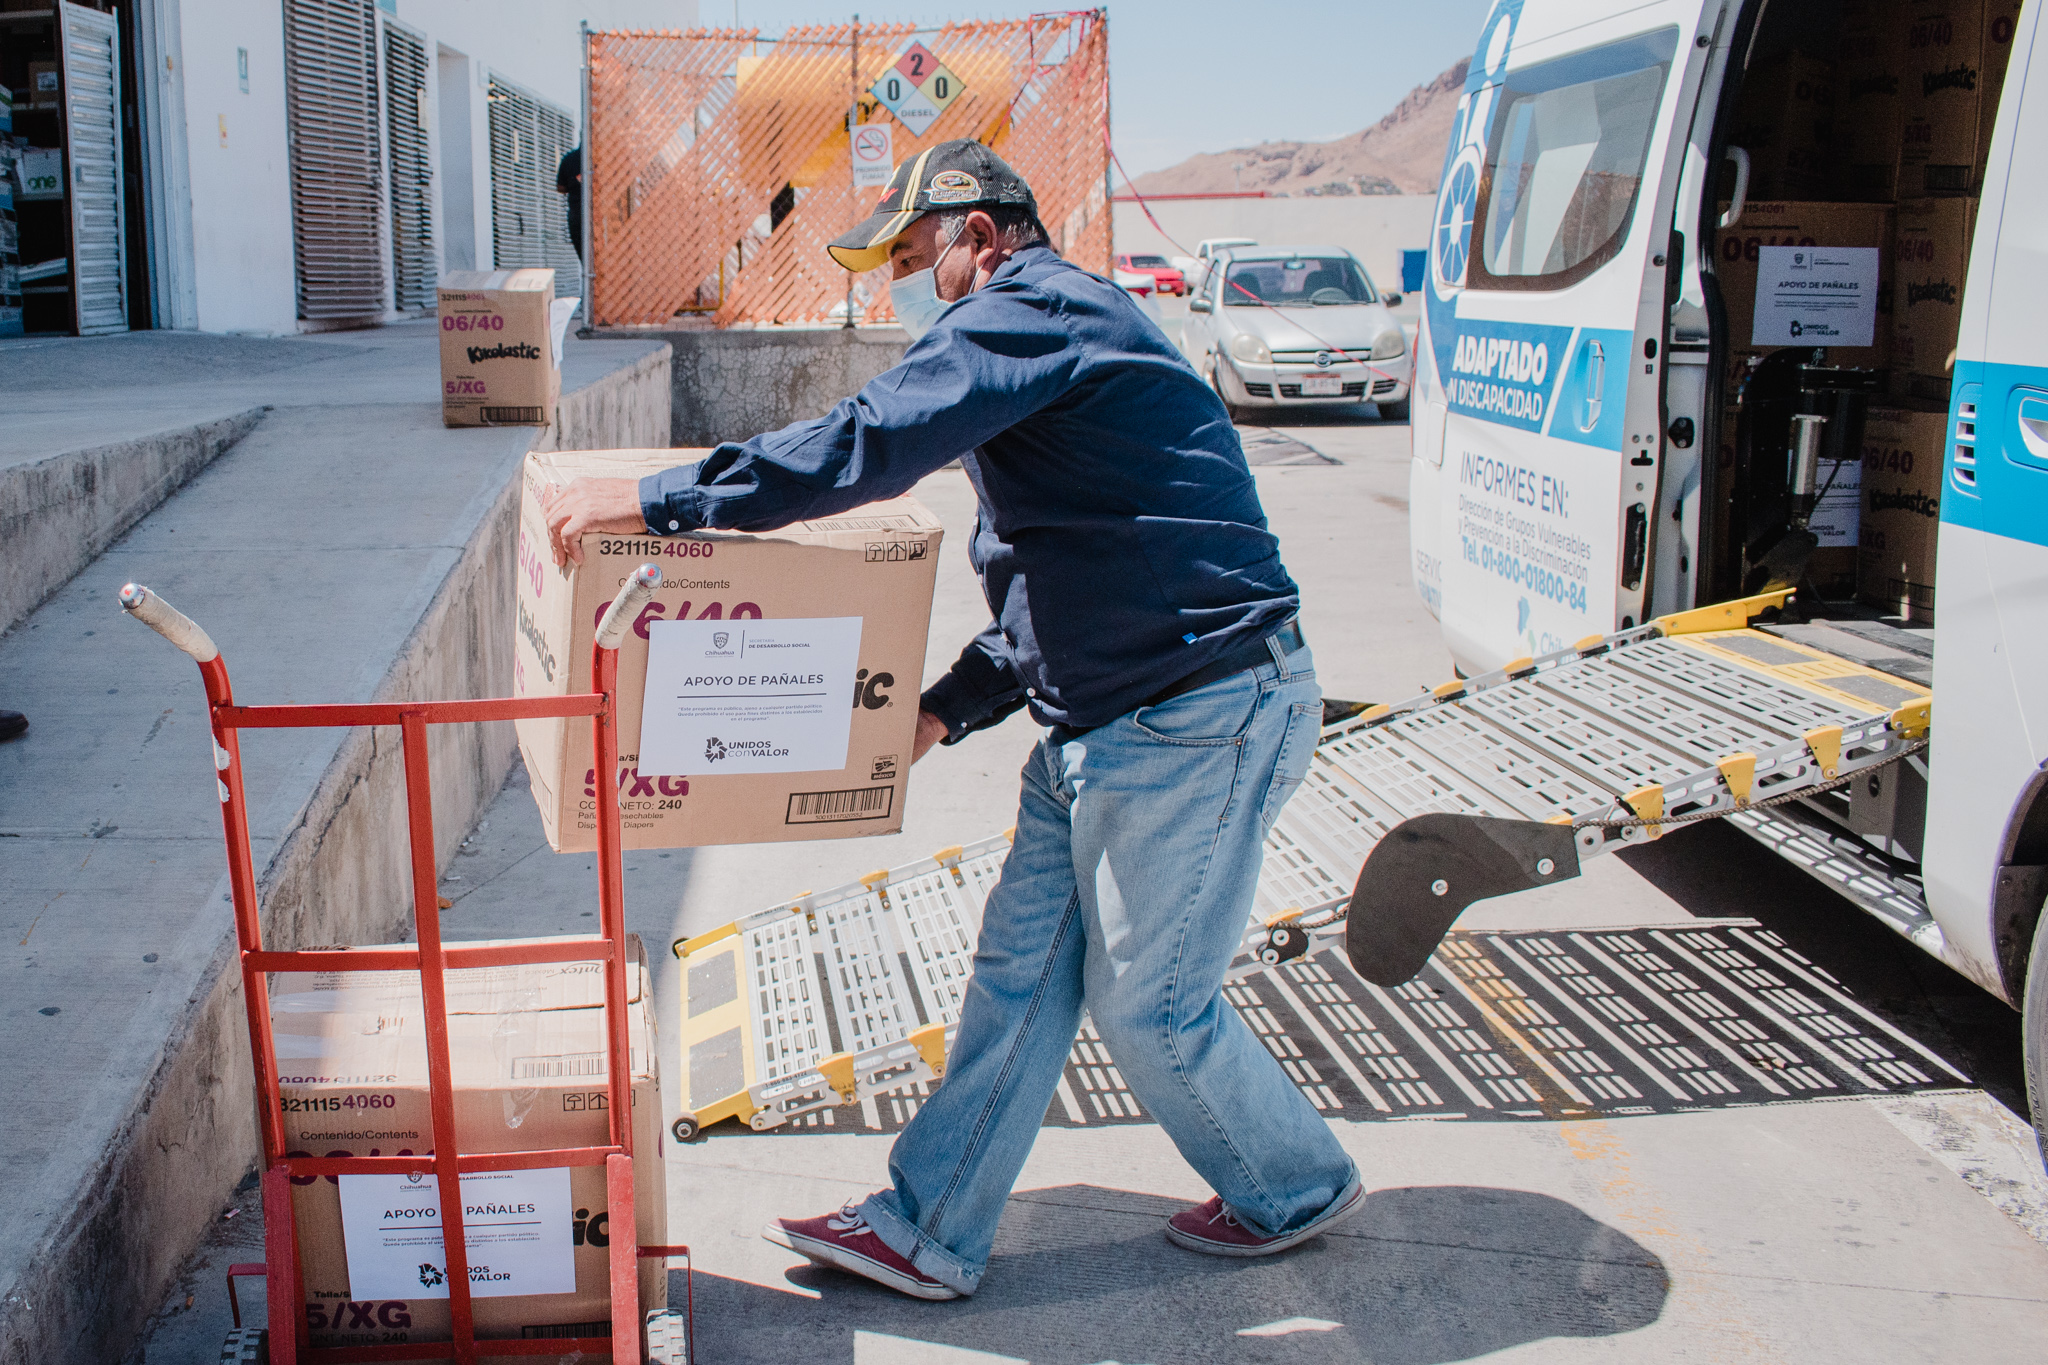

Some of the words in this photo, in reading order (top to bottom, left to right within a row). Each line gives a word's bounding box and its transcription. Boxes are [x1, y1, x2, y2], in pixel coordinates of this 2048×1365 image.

[910, 53, 924, 76] 2
[887, 78, 900, 101] 0
[935, 77, 948, 99] 0
[901, 109, 934, 118] DIESEL
[28, 174, 57, 191] one
[1778, 281, 1806, 289] APOYO
[1822, 280, 1859, 290] PAÑALES
[442, 315, 504, 332] 06/40
[467, 342, 541, 364] Kikolastic
[1452, 334, 1548, 386] ADAPTADO
[445, 381, 486, 394] 5/XG
[1458, 379, 1543, 422] DISCAPACIDAD
[1460, 450, 1536, 507] INFORMES
[1541, 474, 1569, 519] EN:
[1459, 494, 1492, 523] Dirección
[1494, 507, 1504, 526] de
[1506, 511, 1536, 542] Grupos
[1538, 522, 1591, 560] Vulnerables
[1458, 518, 1463, 535] y
[1464, 516, 1504, 548] Prevención
[1506, 536, 1510, 550] a
[1513, 534, 1520, 555] la
[1522, 538, 1588, 583] Discriminación
[1417, 549, 1442, 582] SERVIC
[1462, 535, 1479, 566] Tel.
[1482, 544, 1587, 614] 01-800-01800-84
[618, 578, 730, 589] Cdo/Contents
[684, 676, 733, 686] APOYO
[738, 676, 756, 686] DE
[761, 673, 824, 686] PAÑALES
[728, 740, 772, 749] UNIDOS
[728, 748, 789, 757] conVALOR
[620, 801, 654, 810] NETO:
[658, 800, 682, 810] 240
[300, 1130, 418, 1141] Contenido/Contents
[384, 1207, 436, 1219] APOYO
[466, 1202, 535, 1215] PAÑALES
[306, 1301, 412, 1329] 5/XG
[382, 1332, 408, 1341] 240
